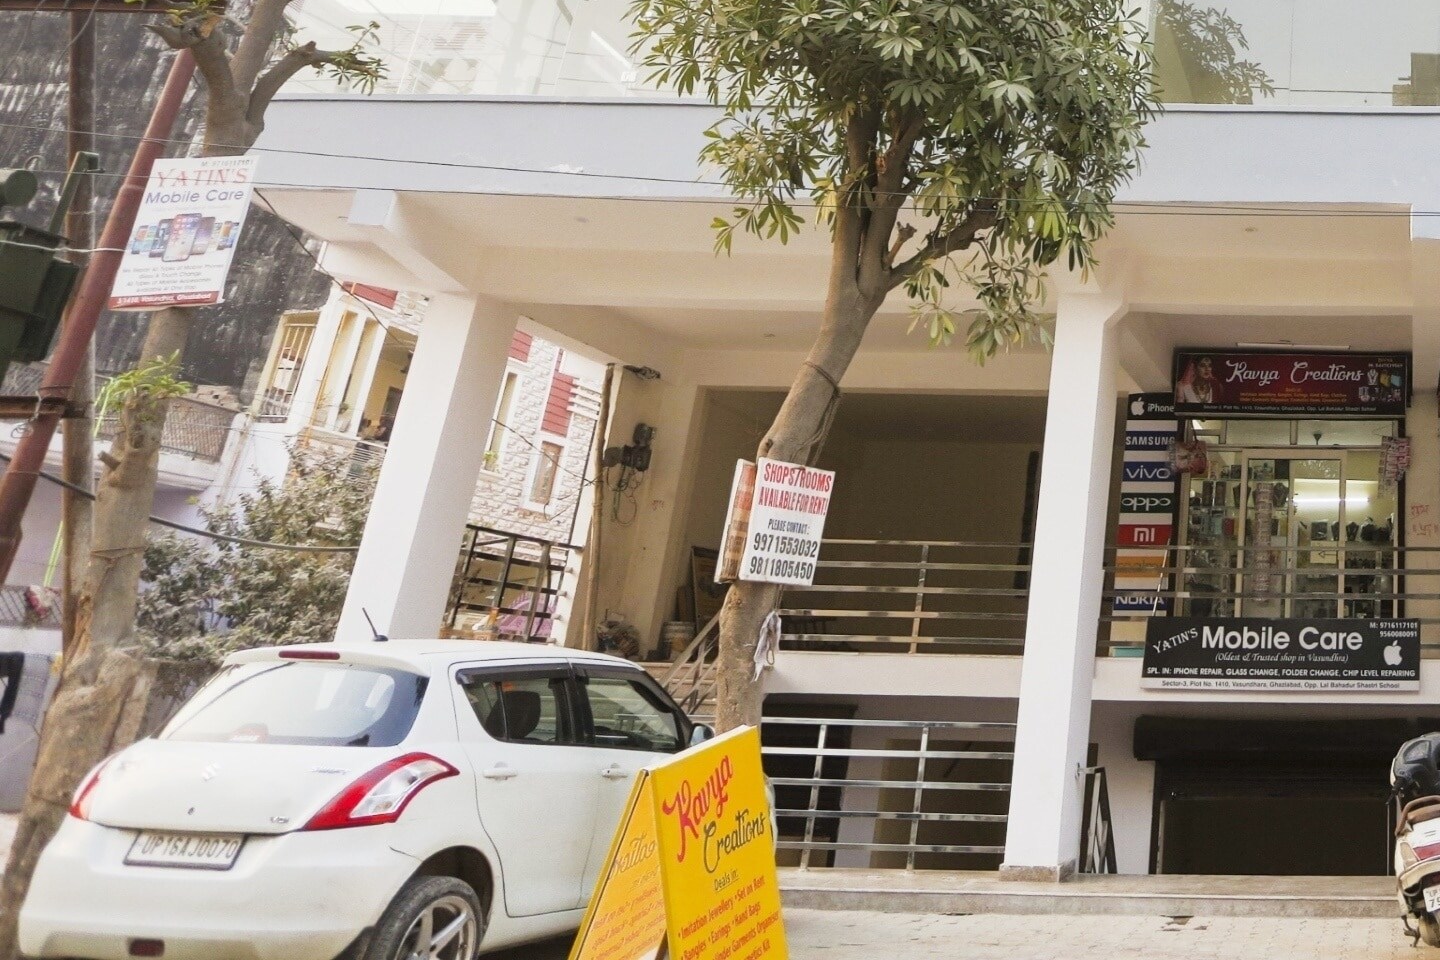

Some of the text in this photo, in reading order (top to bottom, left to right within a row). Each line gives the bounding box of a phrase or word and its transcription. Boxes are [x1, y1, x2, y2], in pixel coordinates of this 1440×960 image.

[157, 168, 248, 188] YATIN'S
[145, 189, 244, 204] Mobile Care
[1226, 360, 1364, 386] Kavya Creations
[1148, 404, 1174, 412] iPhone
[1126, 436, 1176, 446] SAMSUNG
[764, 463, 832, 492] SHOPS/ROOMS
[1126, 465, 1170, 478] vivo
[758, 486, 830, 516] AVAILABLE FOR RENT!
[1122, 498, 1170, 512] oppo
[768, 518, 786, 531] PLEASE
[754, 532, 818, 558] 9971553032
[750, 556, 814, 580] 9811805450
[1116, 596, 1164, 604] NOKIA
[1152, 626, 1363, 654] YATIN'S Mobile Care
[1215, 651, 1349, 664] (Oldest & Trusted shop in Vasundhra)
[1147, 666, 1160, 674] SPL.
[1174, 667, 1198, 675] IPHONE
[1200, 668, 1224, 676] REPAIR,
[1226, 668, 1248, 676] GLASS
[1249, 668, 1280, 677] CHANGE,
[1310, 669, 1340, 678] CHANGE,
[1162, 680, 1188, 688] Sector-3,
[662, 754, 733, 863] Kavya
[704, 808, 767, 874] Creations
[714, 872, 730, 890] Deals
[682, 876, 765, 940] Imitation Jewellery Set on Rent
[735, 910, 748, 926] Hand
[748, 901, 761, 916] Bags
[732, 927, 756, 952] Garments
